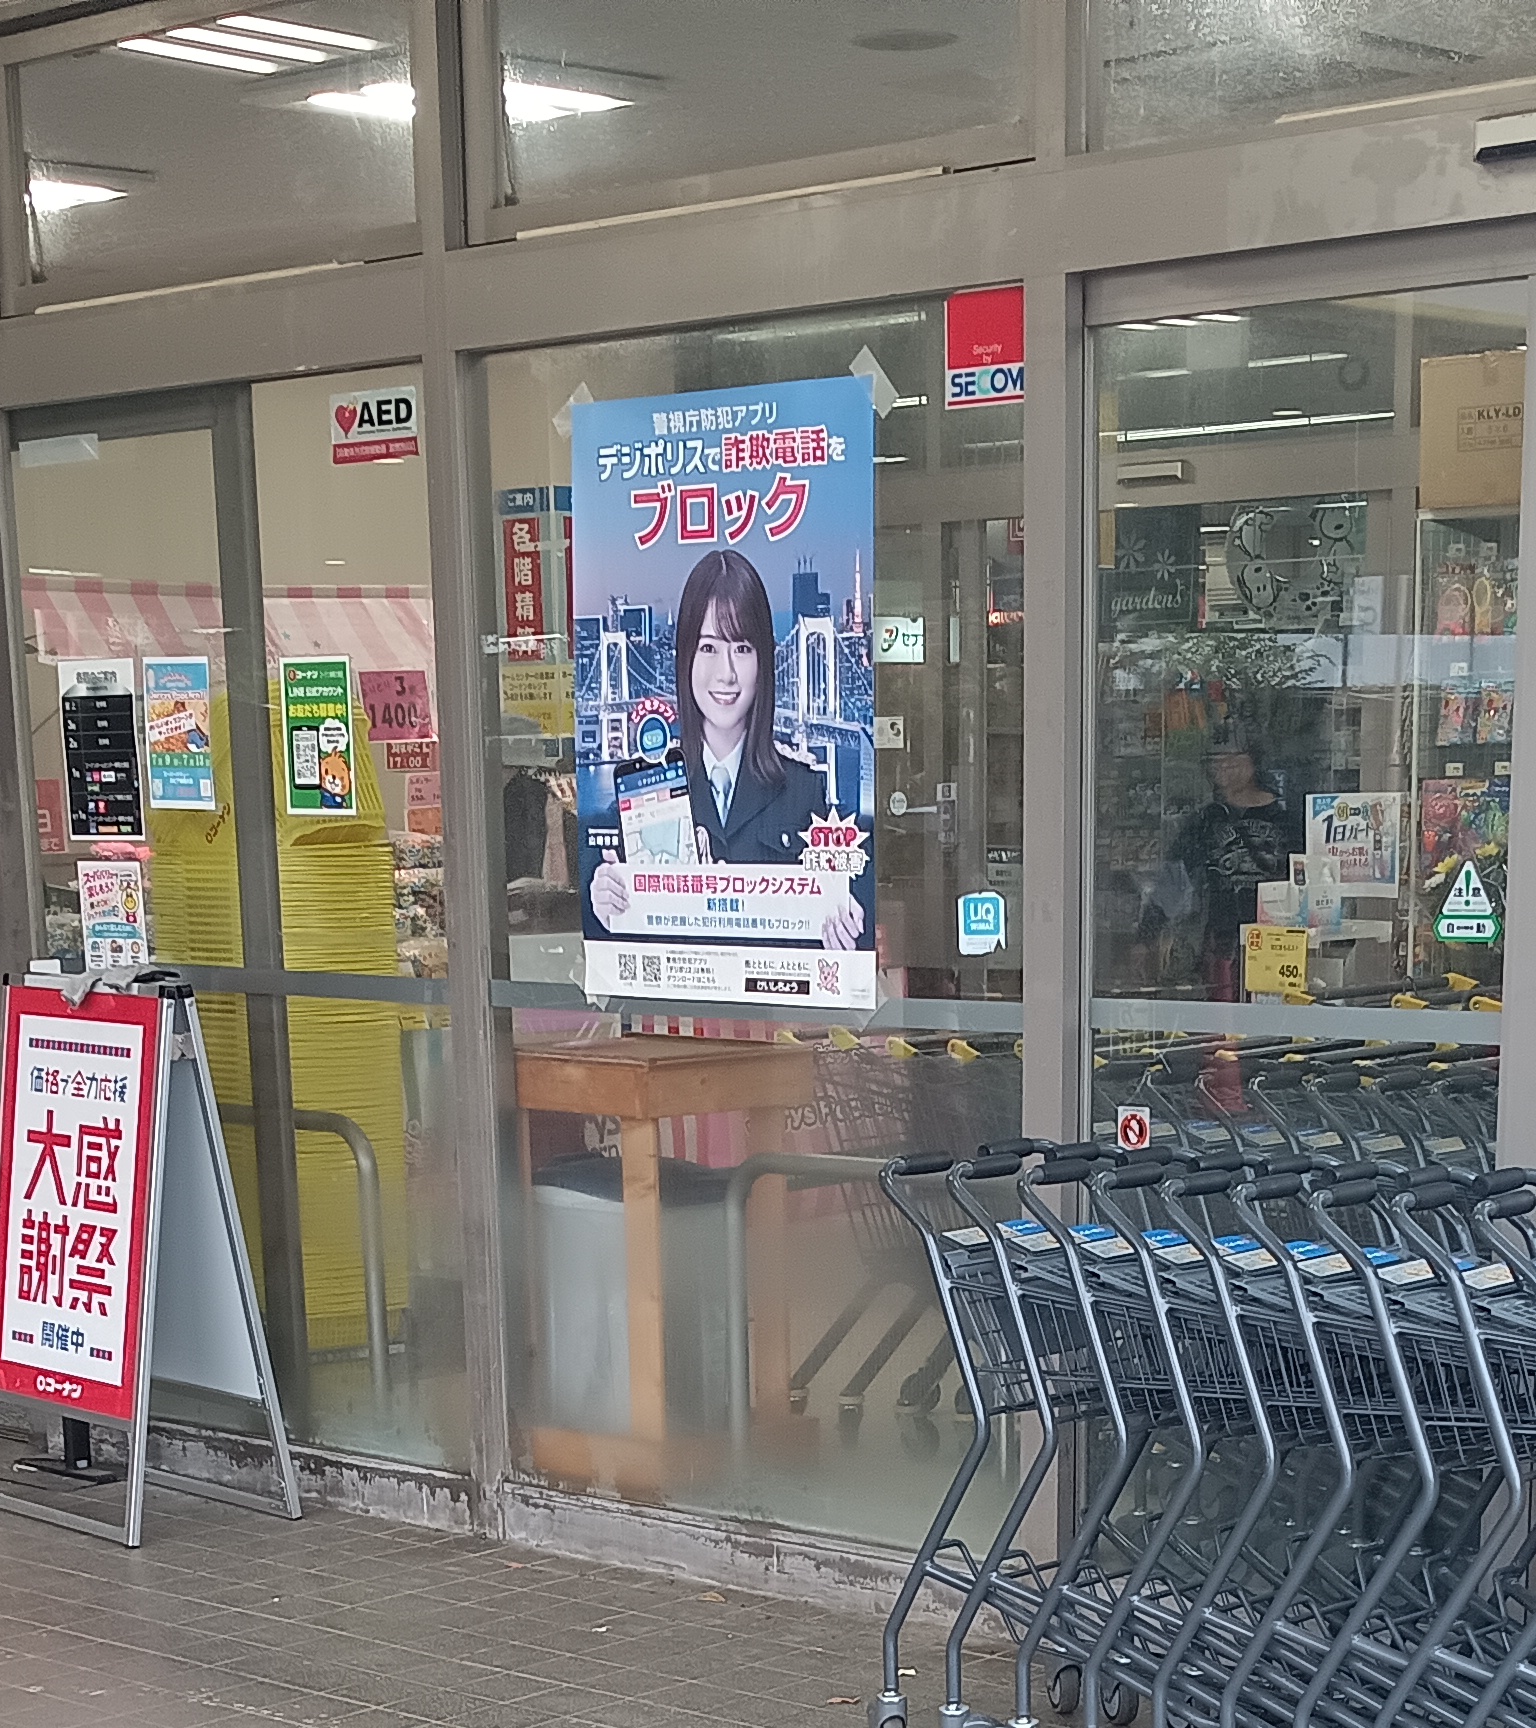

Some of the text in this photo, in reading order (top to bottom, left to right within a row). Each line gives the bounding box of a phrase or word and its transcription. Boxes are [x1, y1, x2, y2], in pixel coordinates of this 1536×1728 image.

[972, 343, 1003, 356] Security
[982, 354, 993, 364] by
[357, 397, 413, 429] AED
[652, 402, 778, 436] 警視庁防犯アプリ
[597, 424, 846, 481] デジポリスで詐欺電話を
[630, 472, 810, 550] ブロック
[296, 669, 319, 680] コーナン
[288, 685, 305, 698] LINE
[810, 826, 858, 848] STOP
[804, 849, 864, 873] 詐欺被害
[633, 873, 823, 896] 国際電話番号ブロックシステム
[1453, 887, 1482, 898] 注意
[706, 897, 746, 913] 新搭載!
[969, 901, 995, 920] UQ
[1278, 965, 1299, 979] 450
[29, 1064, 129, 1104] 価格で全力応援
[23, 1109, 123, 1215] 大感
[17, 1208, 118, 1317] 謝祭
[40, 1321, 85, 1355] 開催中
[42, 1375, 82, 1399] コーナン
